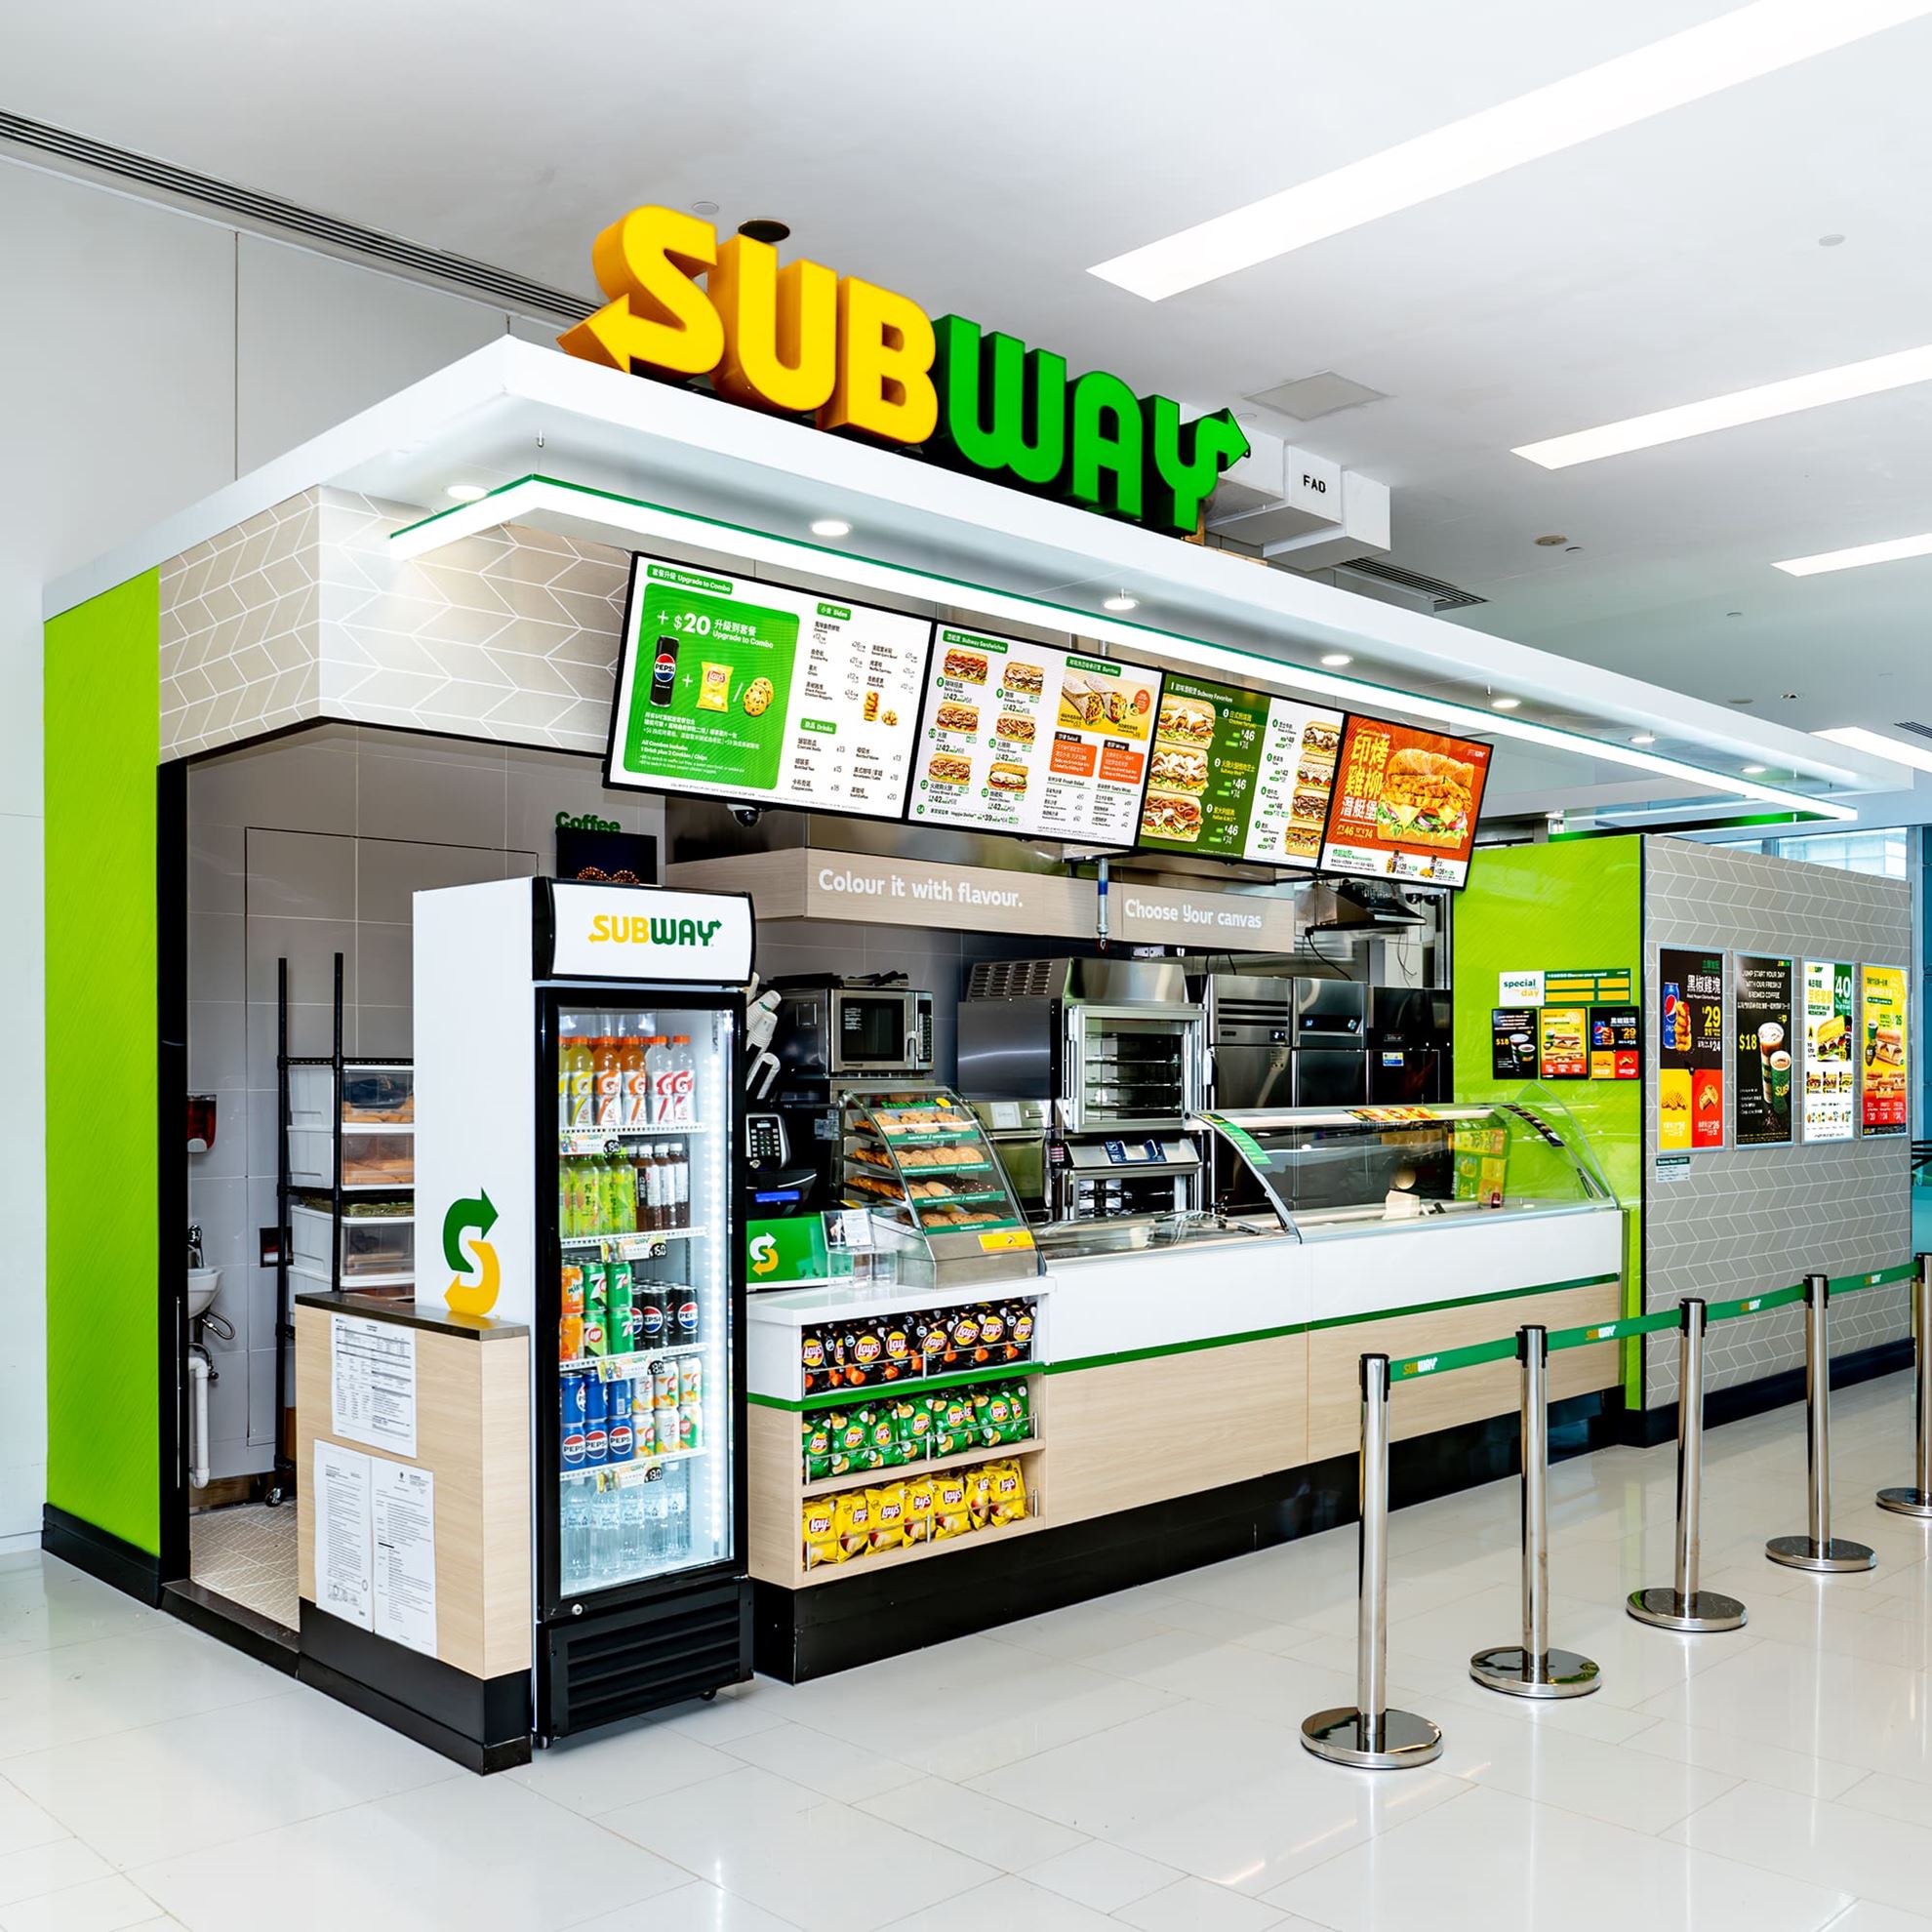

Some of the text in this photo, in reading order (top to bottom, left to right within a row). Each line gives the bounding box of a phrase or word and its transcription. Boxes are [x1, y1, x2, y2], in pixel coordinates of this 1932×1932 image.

[558, 204, 1250, 534] SUBWAY
[1303, 474, 1326, 494] FAD
[673, 613, 711, 635] $20
[712, 629, 742, 643] Upgrade
[749, 638, 773, 649] Combo
[555, 811, 621, 832] Coffee
[818, 868, 1024, 907] Colour it with flavour.
[1125, 899, 1178, 921] Choose
[1217, 911, 1263, 928] canvas
[587, 915, 722, 946] SUBWAY
[1504, 979, 1536, 988] special
[1739, 1032, 1757, 1051] $18
